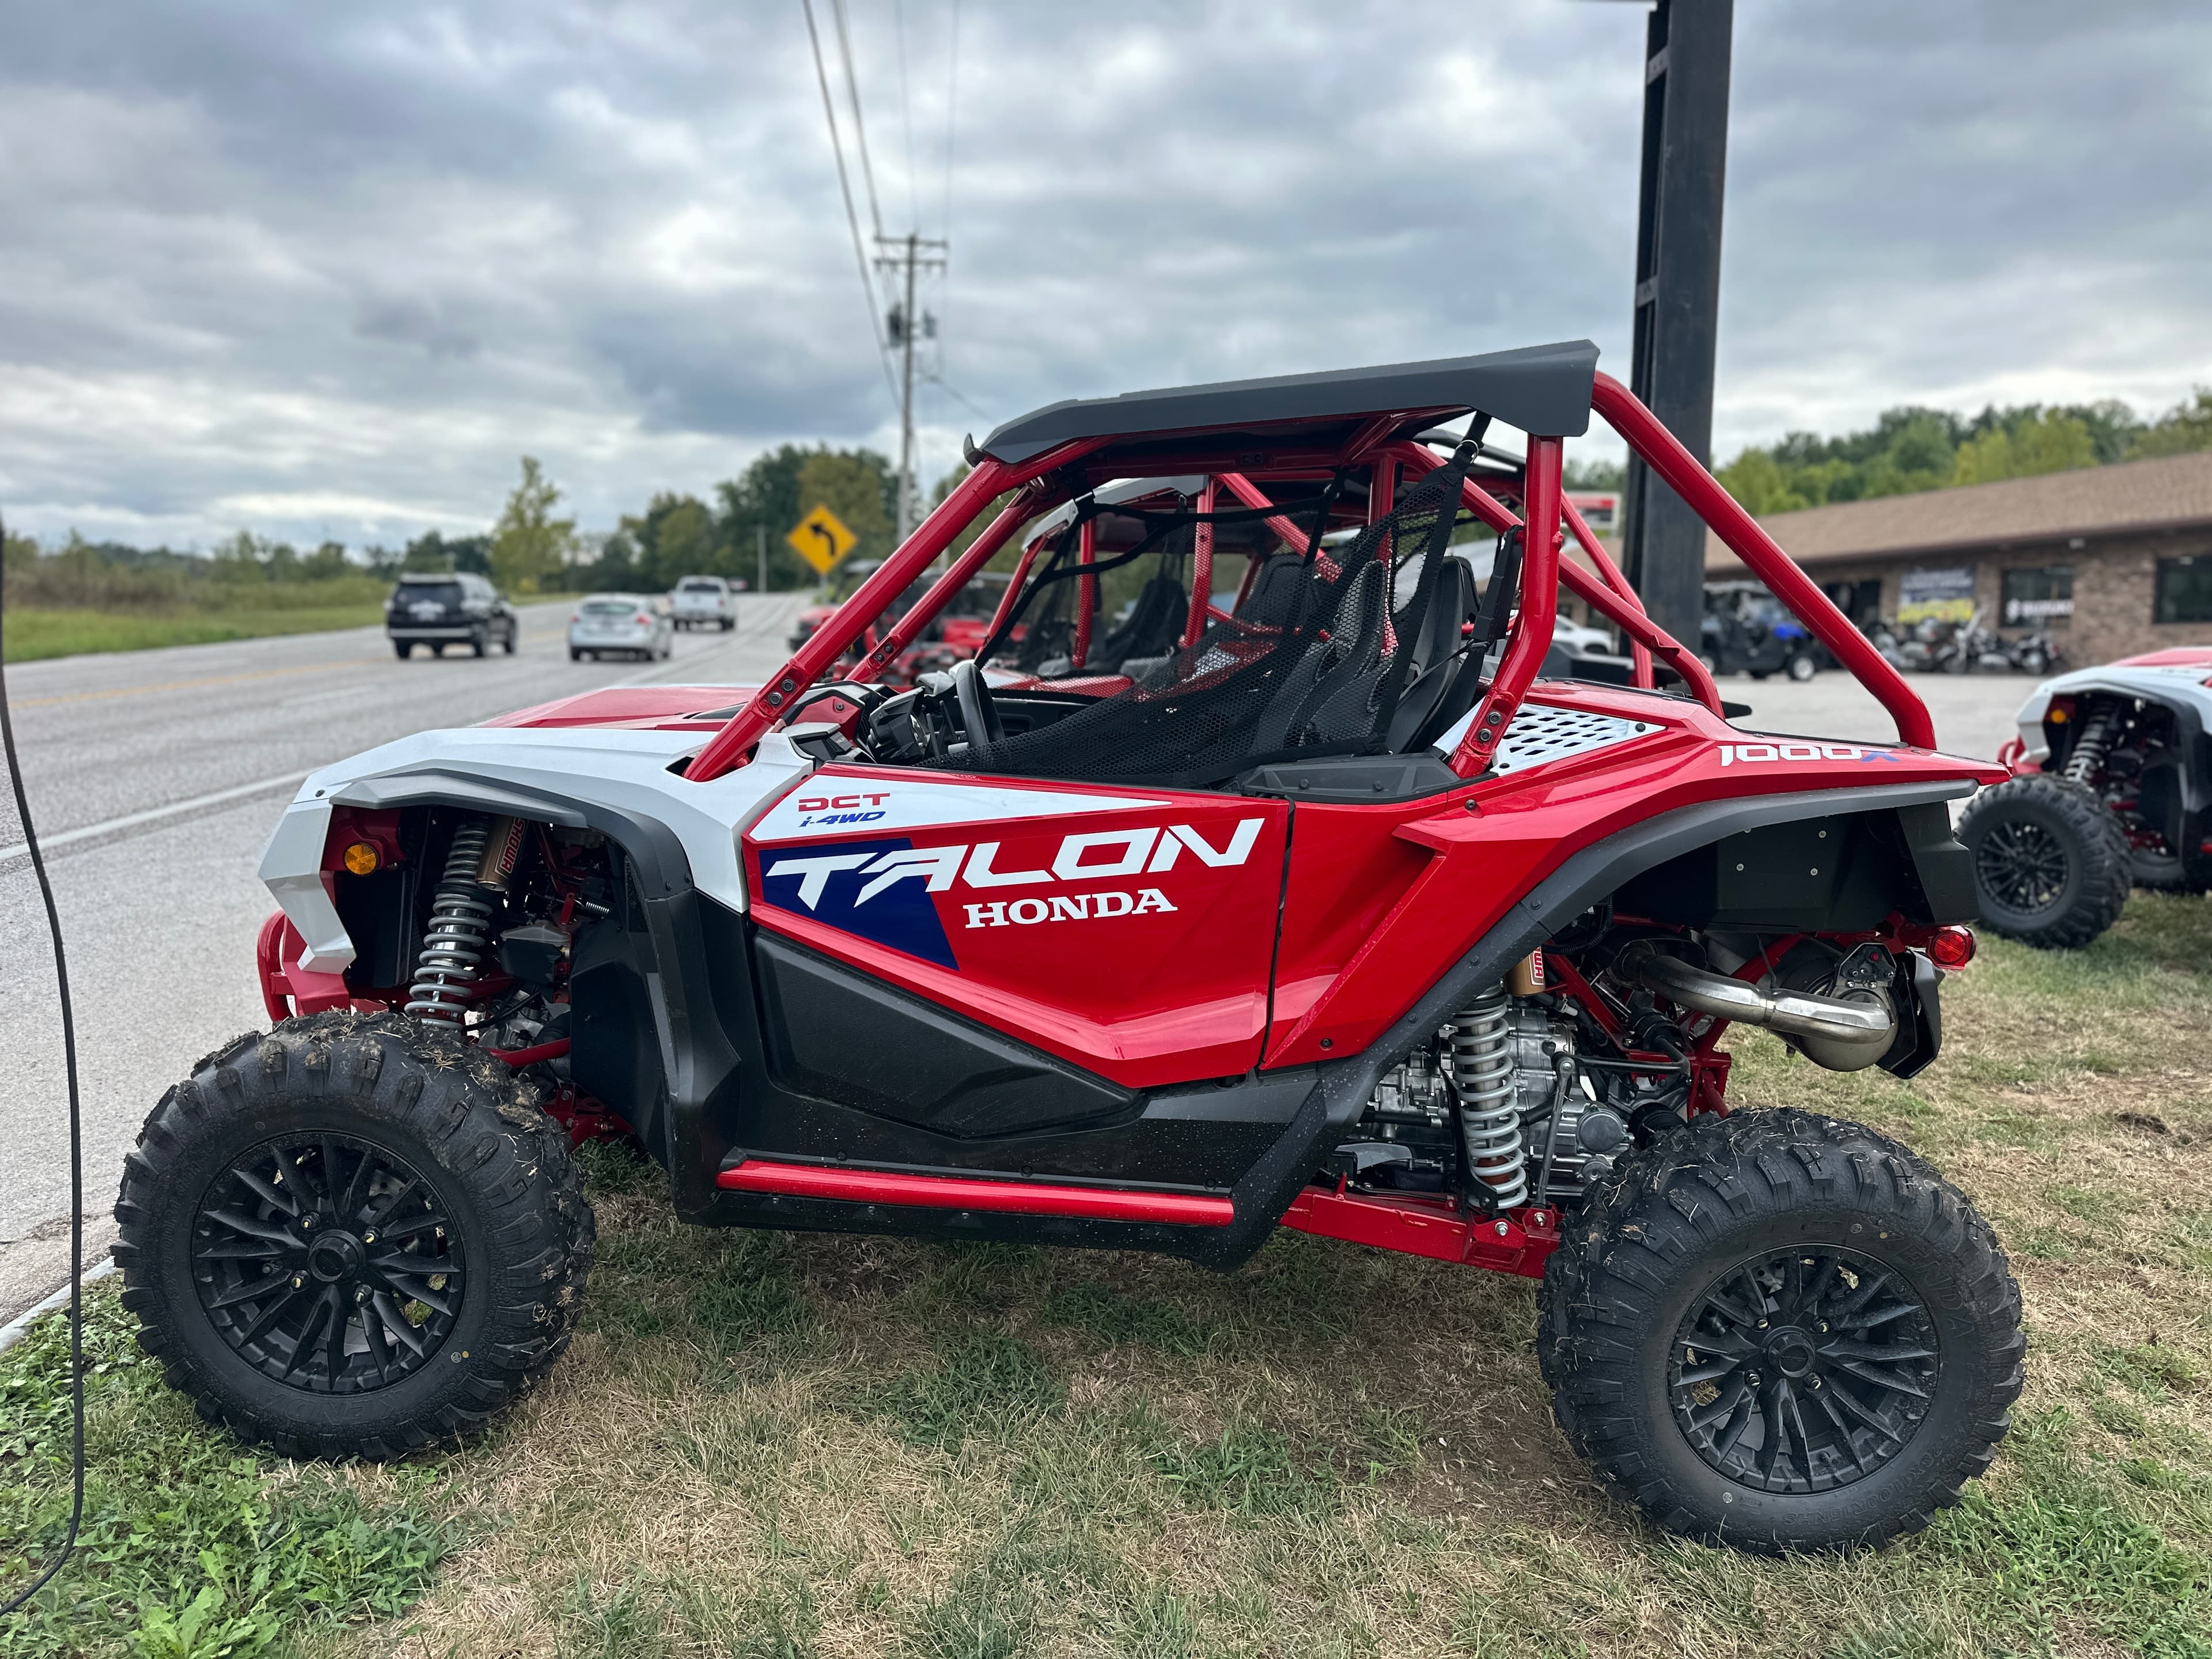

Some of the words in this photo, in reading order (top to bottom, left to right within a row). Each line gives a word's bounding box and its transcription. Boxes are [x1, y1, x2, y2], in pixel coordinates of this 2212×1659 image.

[1717, 745, 1900, 767] 1000X
[798, 793, 891, 812] DCT
[798, 810, 886, 827] i-4WD
[500, 817, 525, 873] SHOWA
[766, 817, 1265, 911] TALON
[963, 888, 1177, 929] HONDA
